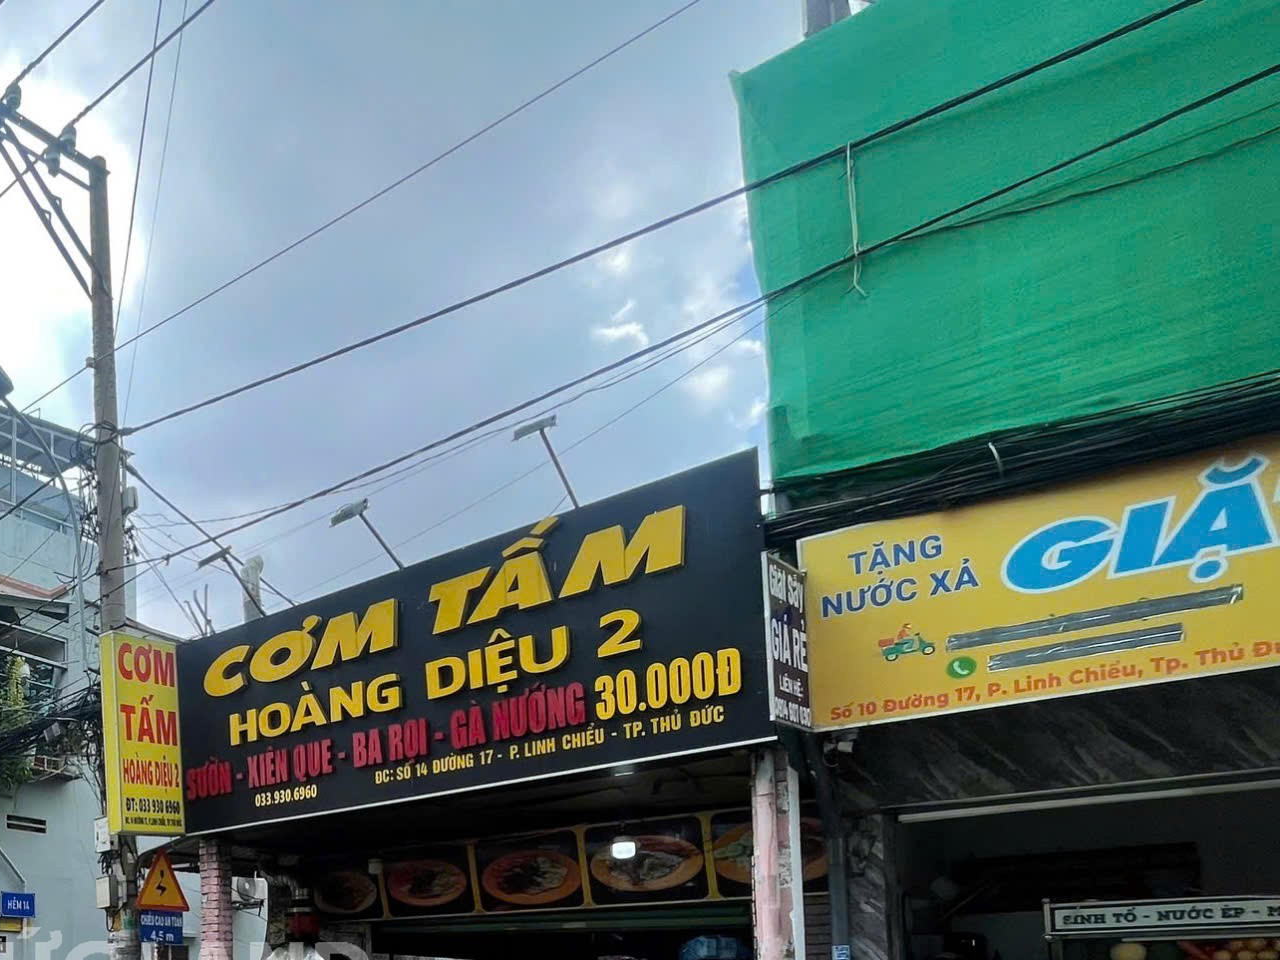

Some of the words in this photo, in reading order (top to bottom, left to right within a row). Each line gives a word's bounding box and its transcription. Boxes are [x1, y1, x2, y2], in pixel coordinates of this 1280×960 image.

[1001, 454, 1280, 594] GIẶ
[847, 535, 942, 575] TẶNG
[203, 598, 399, 697] CƠM
[428, 504, 686, 636] TẤM
[822, 578, 917, 618] NƯỚC
[930, 558, 979, 596] XẢ
[118, 642, 175, 688] CƠM
[771, 614, 791, 666] GIÁ
[792, 619, 808, 672] RẺ
[228, 672, 403, 746] HOÀNG
[425, 625, 569, 700] DIỆU
[597, 609, 642, 658] 2
[594, 648, 742, 720] 30.000Đ
[830, 702, 851, 721] Số
[858, 702, 877, 715] 10
[883, 692, 949, 709] Đường
[955, 686, 980, 702] 17,
[1014, 673, 1061, 693] Linh
[1150, 656, 1188, 675] Tp.
[1194, 642, 1244, 667] Thủ
[120, 695, 178, 747] TẤM
[247, 746, 290, 788] XIÊN
[293, 739, 334, 782] QUE
[352, 728, 383, 768] BA
[388, 718, 429, 764] RỌI
[450, 700, 486, 749] GÀ
[492, 681, 586, 740] NƯỚNG
[375, 769, 394, 785] ĐC:
[396, 762, 412, 781] SỐ
[415, 762, 428, 777] 14
[432, 753, 474, 774] ĐƯỜNG
[480, 750, 493, 765] 17
[509, 745, 520, 760] P.
[524, 737, 556, 758] LINH
[562, 722, 604, 749] CHIỂU
[623, 722, 646, 740] TP.
[651, 708, 681, 735] THỦ
[690, 705, 725, 725] ĐỨC
[123, 752, 153, 785] HOÀNG
[154, 755, 173, 794] DIỆU
[174, 763, 180, 788] 2
[255, 784, 317, 807] 033.930.6960
[126, 797, 138, 812] ĐT:
[139, 798, 151, 813] 033
[150, 930, 164, 942] 4,5
[165, 933, 174, 941] m
[1062, 911, 1107, 925] SINH
[1113, 907, 1137, 923] TỐ
[1157, 906, 1214, 921] NƯỚC
[1221, 904, 1245, 919] ÉP
